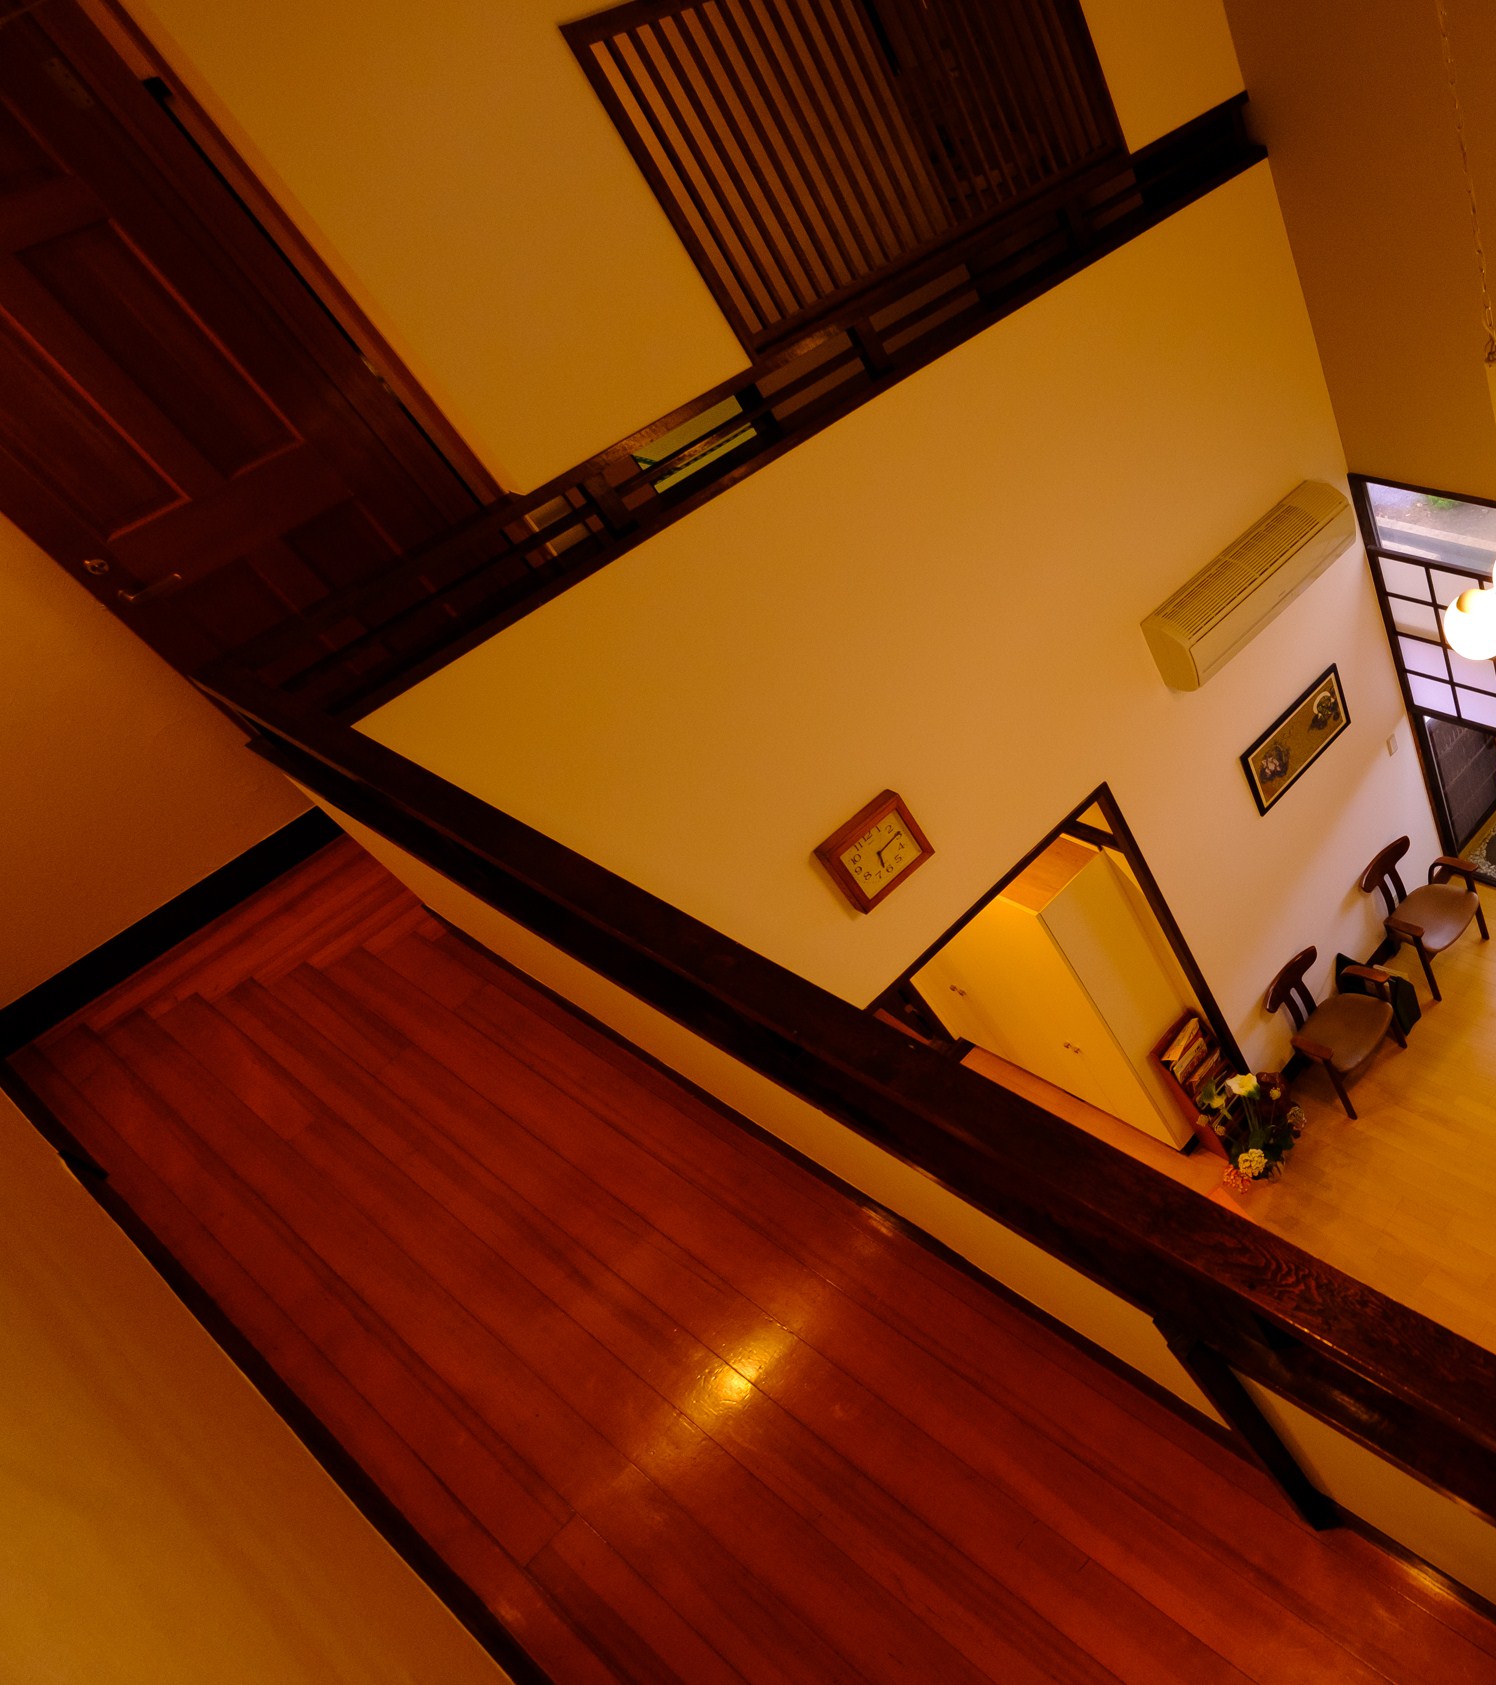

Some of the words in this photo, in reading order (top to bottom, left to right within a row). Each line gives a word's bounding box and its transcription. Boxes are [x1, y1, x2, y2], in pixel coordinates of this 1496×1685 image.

[875, 825, 882, 833] 1
[885, 824, 894, 834] 2
[861, 830, 873, 843] 12
[853, 841, 864, 852] 11
[897, 842, 905, 851] 4
[850, 854, 862, 865] 10
[894, 854, 902, 863] 5
[854, 866, 863, 875] 9
[885, 864, 894, 874] 6
[863, 871, 872, 881] 8
[875, 870, 883, 880] 7
